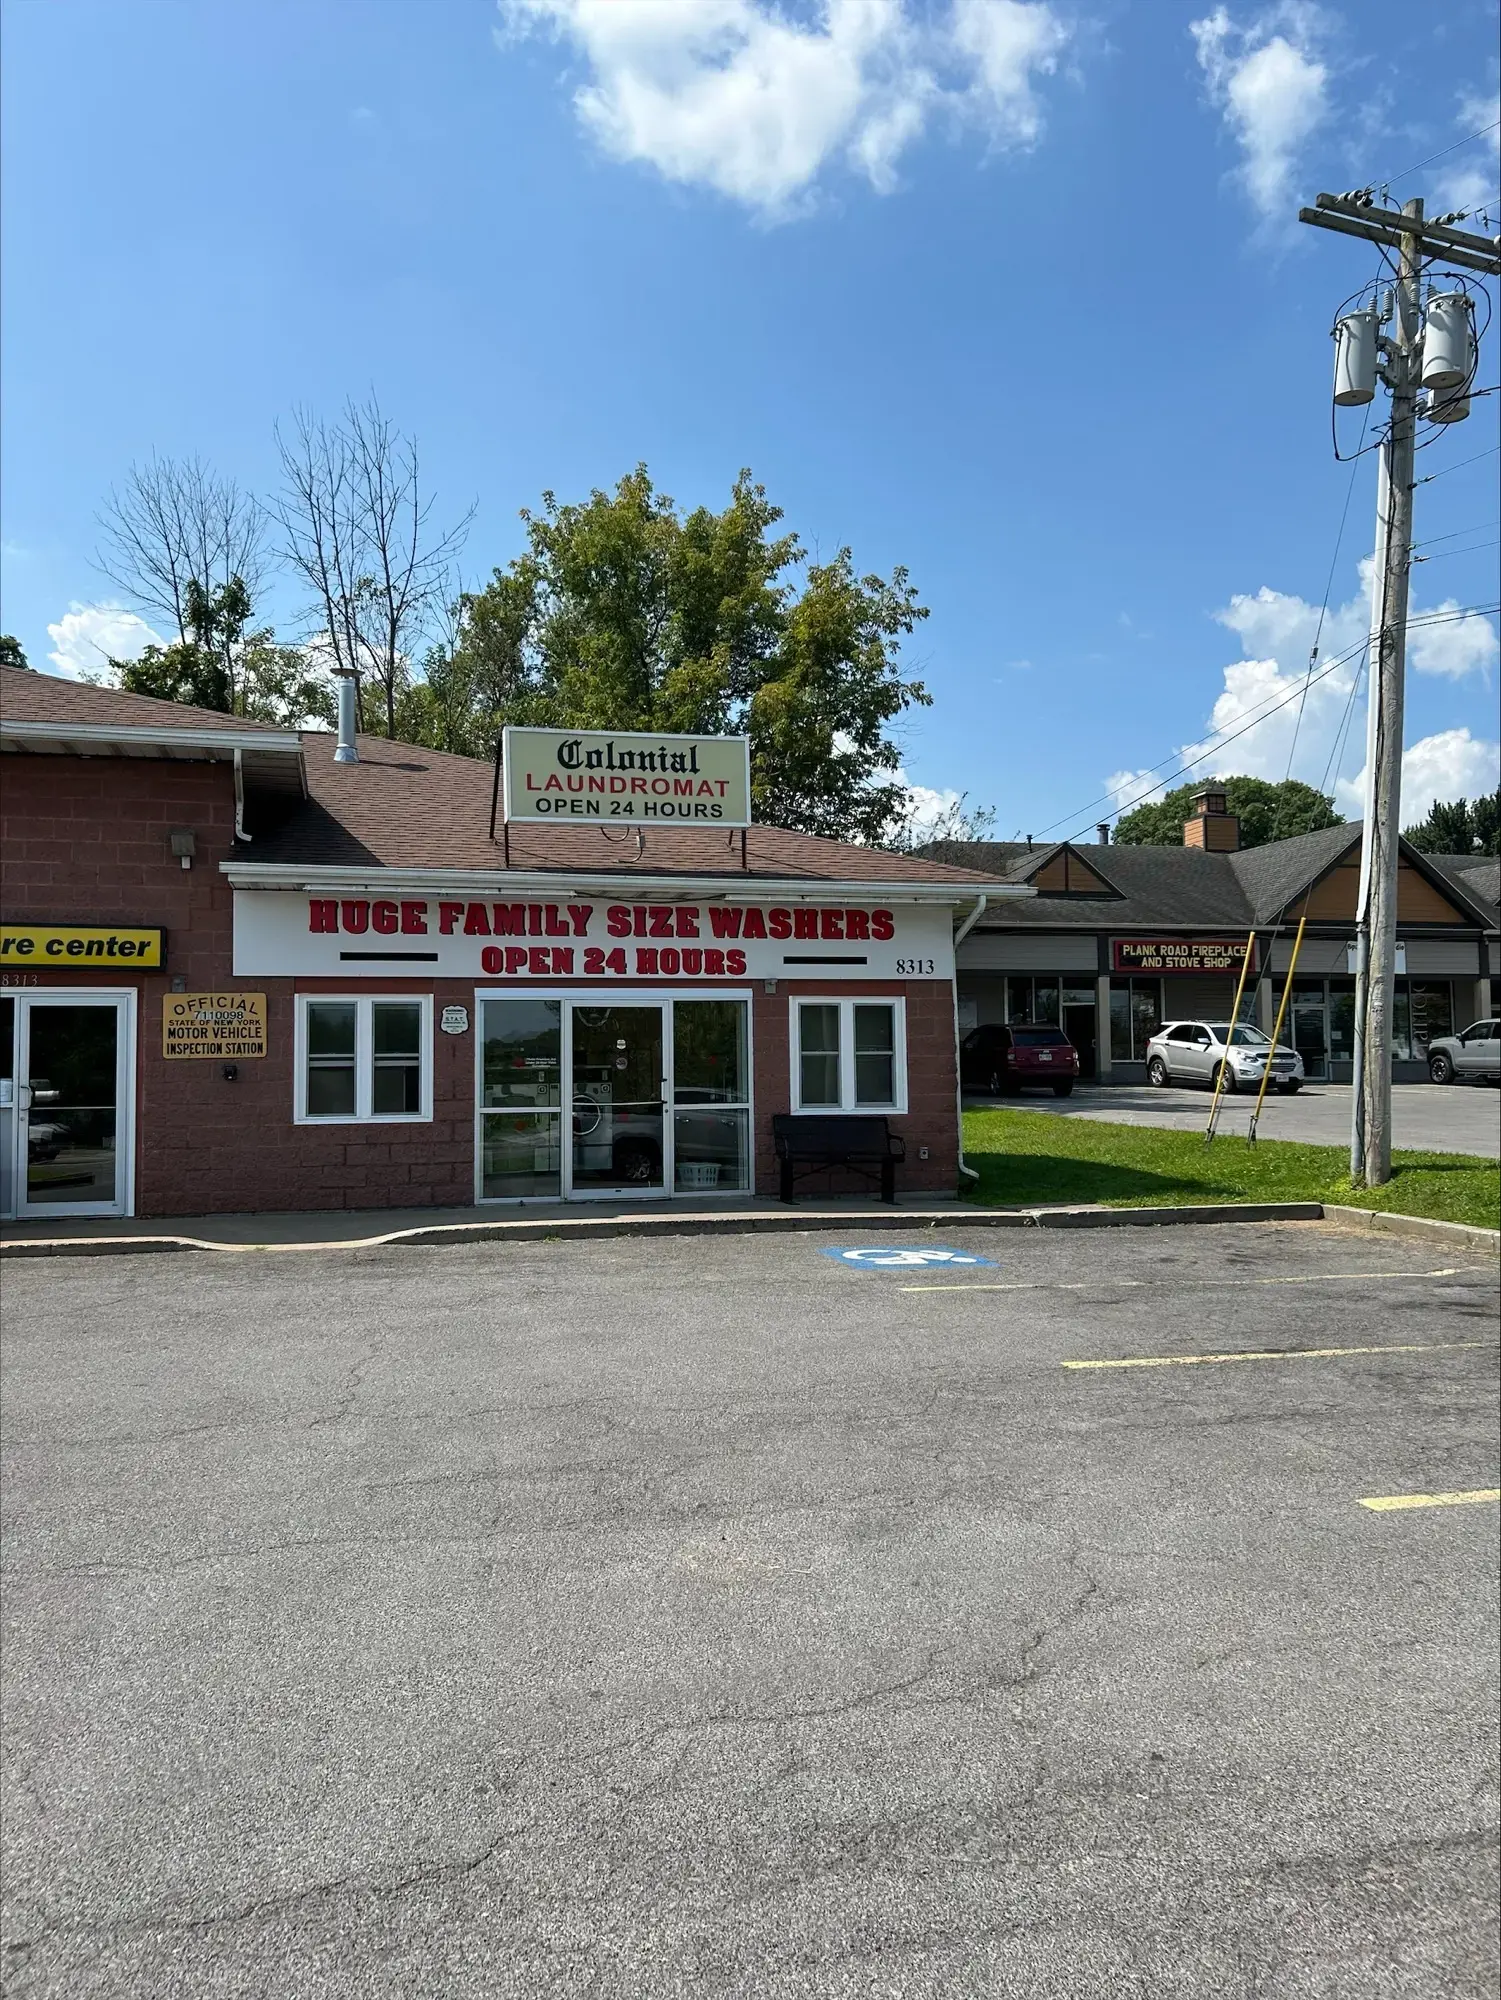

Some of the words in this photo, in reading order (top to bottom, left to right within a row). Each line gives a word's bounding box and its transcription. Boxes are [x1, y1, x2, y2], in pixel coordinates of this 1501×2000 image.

[557, 739, 700, 775] Colonial
[526, 773, 730, 798] LAUNDROMAT
[535, 798, 600, 815] OPEN
[610, 801, 635, 816] 24
[644, 802, 723, 818] HOURS
[308, 899, 428, 935] HUGE
[438, 902, 593, 937] FAMILY
[607, 905, 699, 938] SIZE
[708, 907, 895, 940] WASHERS
[0, 937, 35, 955] re
[46, 936, 151, 957] center
[1123, 945, 1156, 956] PLANK
[1160, 945, 1188, 956] ROAD
[1192, 945, 1247, 957] FIREPLACE
[481, 946, 574, 974] OPEN
[583, 948, 627, 974] 24
[635, 948, 747, 975] HOURS
[896, 959, 935, 975] 8313
[1141, 957, 1162, 968] AND
[1165, 957, 1200, 968] STOVE
[1203, 957, 1231, 968] SHOP
[2, 974, 38, 987] 8313
[173, 996, 259, 1016] OFFICIAL
[194, 1010, 244, 1020] 7110098
[168, 1027, 208, 1039] MOTOR
[212, 1027, 262, 1039] VEHICLE
[166, 1042, 222, 1055] INSPECTION
[225, 1042, 263, 1054] STATION
